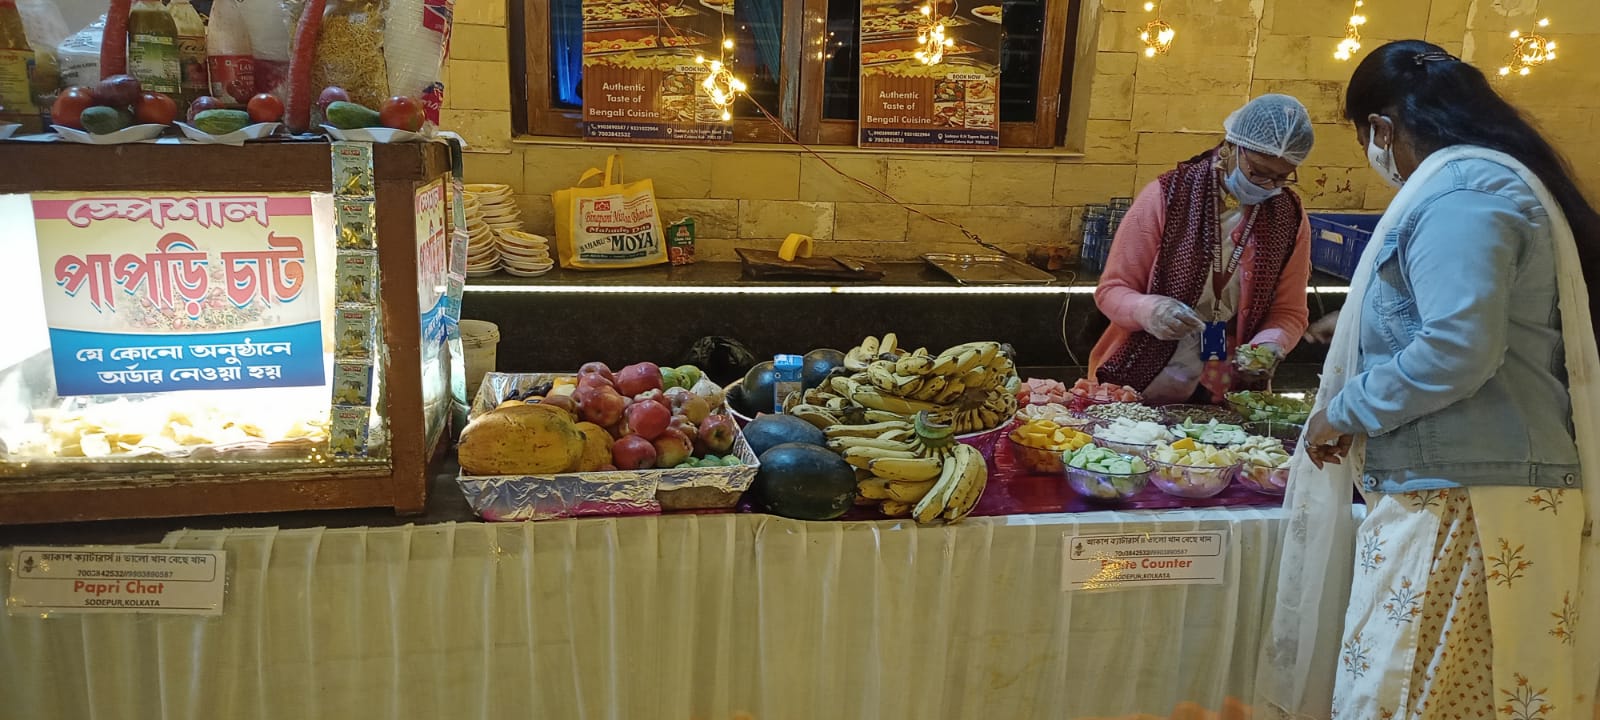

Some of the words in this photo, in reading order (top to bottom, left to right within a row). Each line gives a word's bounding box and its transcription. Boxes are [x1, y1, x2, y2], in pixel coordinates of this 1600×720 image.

[602, 82, 646, 92] Authentic
[606, 94, 630, 103] Taste
[633, 95, 641, 103] of
[879, 90, 919, 99] Authentic
[883, 102, 904, 110] Taste
[906, 102, 915, 110] of
[590, 108, 624, 118] Bengali
[627, 109, 660, 118] Cuisine
[867, 116, 899, 124] Bengali
[902, 116, 932, 124] Cuisine
[66, 196, 270, 229] স্পেশাল
[611, 232, 654, 251] MOYA
[54, 232, 209, 320] পাপড়ি
[220, 230, 305, 310] চাট
[76, 347, 104, 362] যে
[110, 345, 184, 362] কোনো
[188, 337, 292, 365] অনুষ্ঠানে
[97, 363, 164, 385] অর্ডার
[169, 365, 242, 382] নেওয়া
[247, 365, 282, 380] হয়
[41, 553, 72, 561] আকাশ
[151, 556, 166, 564] খান
[191, 556, 206, 564] খান
[1141, 558, 1192, 569] Counter
[74, 580, 120, 596] Papri
[126, 580, 164, 594] Chat
